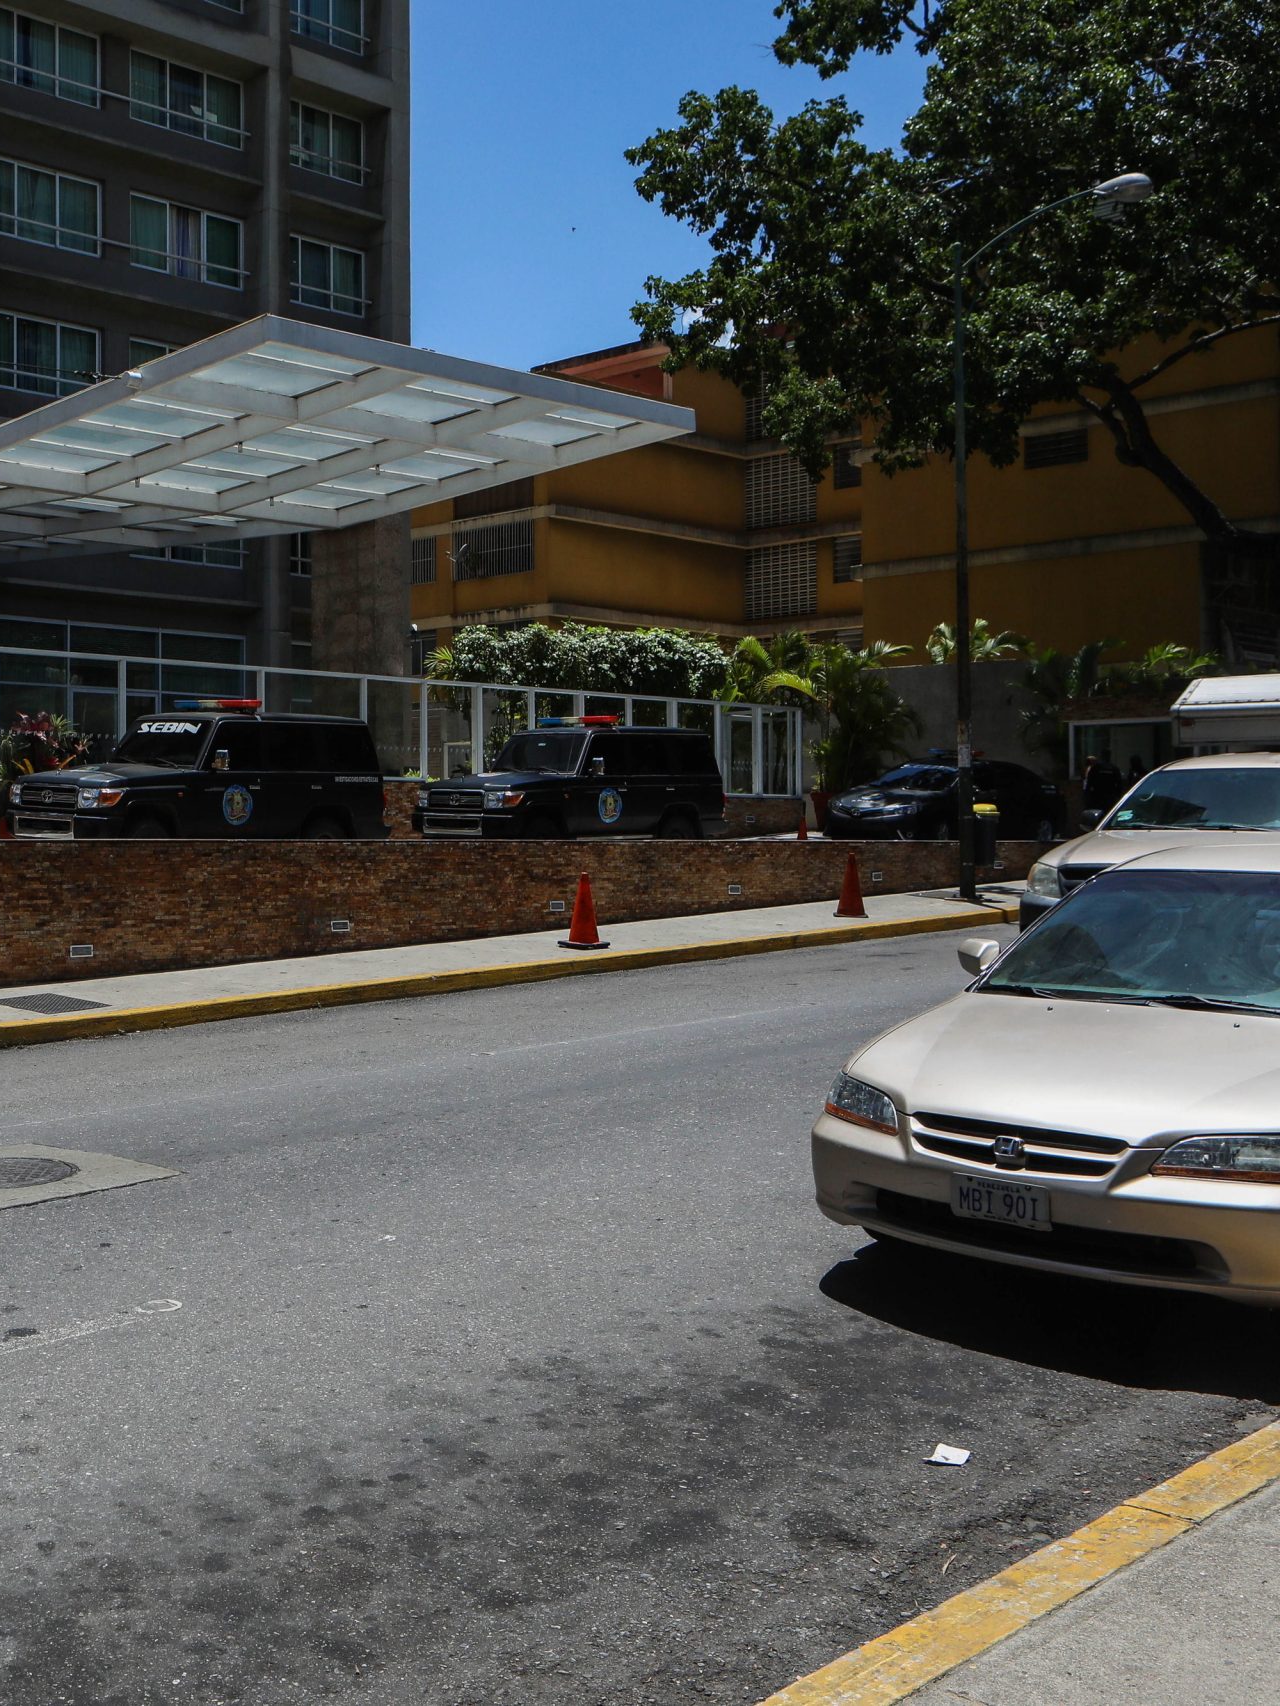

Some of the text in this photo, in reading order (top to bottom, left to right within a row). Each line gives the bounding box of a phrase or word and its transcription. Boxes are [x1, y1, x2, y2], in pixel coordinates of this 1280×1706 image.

[137, 722, 202, 734] SEBIN
[977, 1181, 1021, 1193] VENEZUELA
[959, 1186, 993, 1214] MBI
